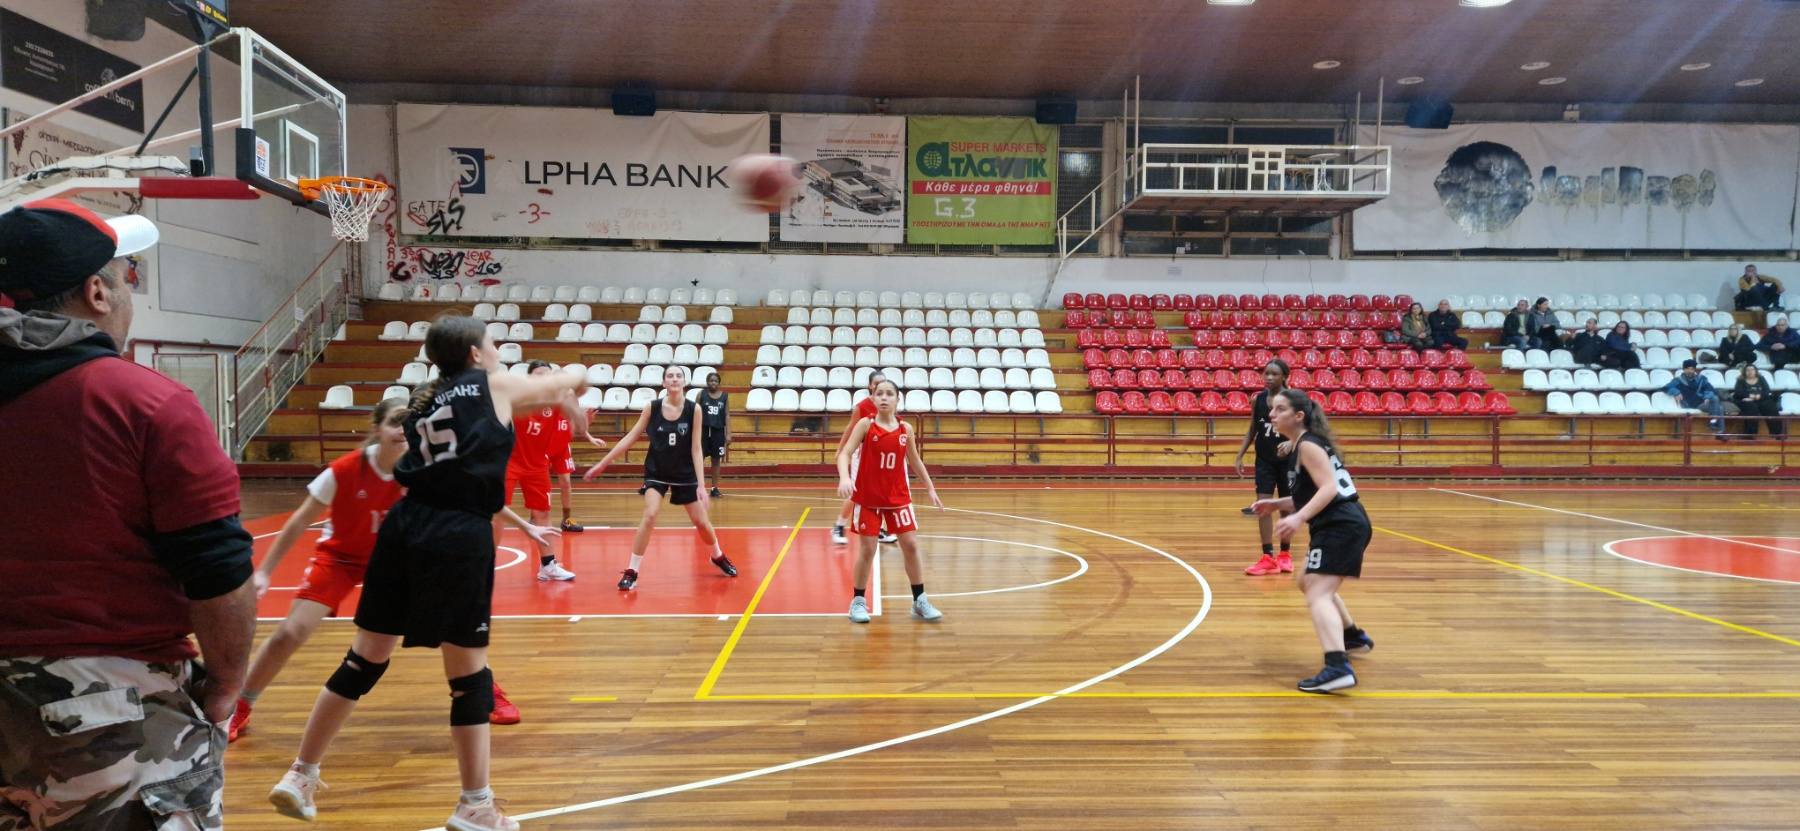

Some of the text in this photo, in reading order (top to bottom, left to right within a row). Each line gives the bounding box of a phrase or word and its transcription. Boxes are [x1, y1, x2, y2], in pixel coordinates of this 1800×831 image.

[951, 143, 1047, 153] SUPER MARKETS
[626, 163, 730, 189] BANK
[707, 405, 719, 415] 39
[526, 421, 542, 436] 15
[558, 420, 569, 431] 16
[415, 405, 459, 467] 15
[668, 432, 677, 446] 8
[880, 452, 896, 470] 10
[893, 508, 912, 528] 10
